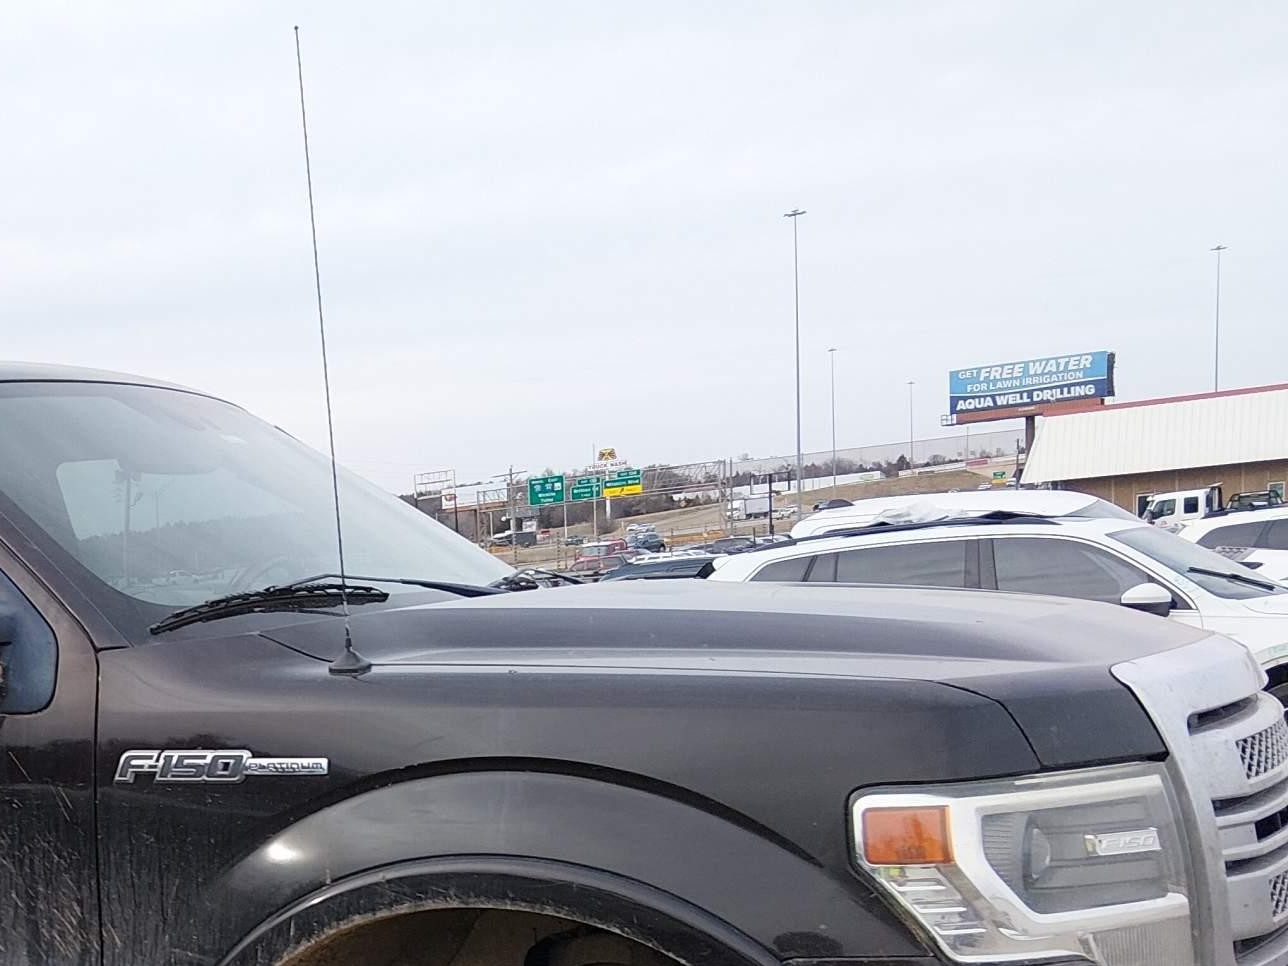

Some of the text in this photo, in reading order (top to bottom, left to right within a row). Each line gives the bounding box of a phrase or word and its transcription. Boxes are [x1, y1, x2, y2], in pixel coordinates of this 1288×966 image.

[958, 354, 1093, 381] GET FREE WATER
[966, 371, 1084, 393] FOR LAWN IRRIGATION
[956, 384, 1096, 411] AQUA WELL DRILLING
[114, 750, 326, 784] F-150 PLATINUM
